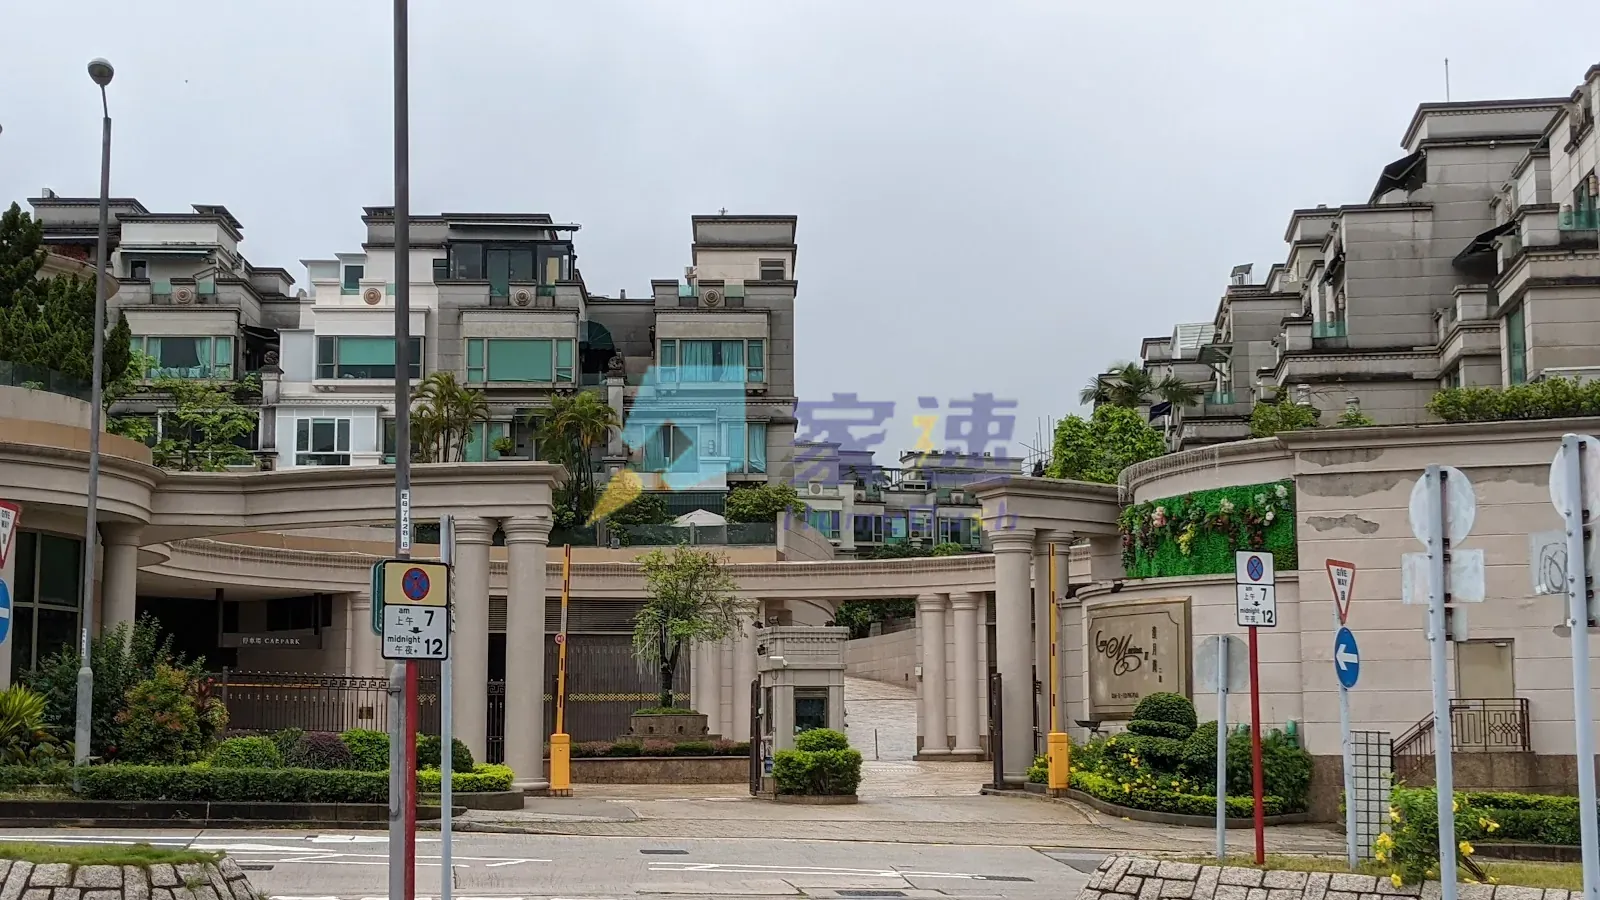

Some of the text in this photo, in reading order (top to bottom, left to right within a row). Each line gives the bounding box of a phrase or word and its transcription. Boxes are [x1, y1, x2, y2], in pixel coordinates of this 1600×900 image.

[1336, 567, 1348, 577] GIVE
[1337, 578, 1348, 586] WAY
[1260, 587, 1267, 601] 7
[395, 616, 414, 626] 上午
[424, 610, 434, 627] 7
[1261, 609, 1274, 623] 12
[387, 634, 443, 655] midnight 12
[394, 645, 413, 655] 午夜
